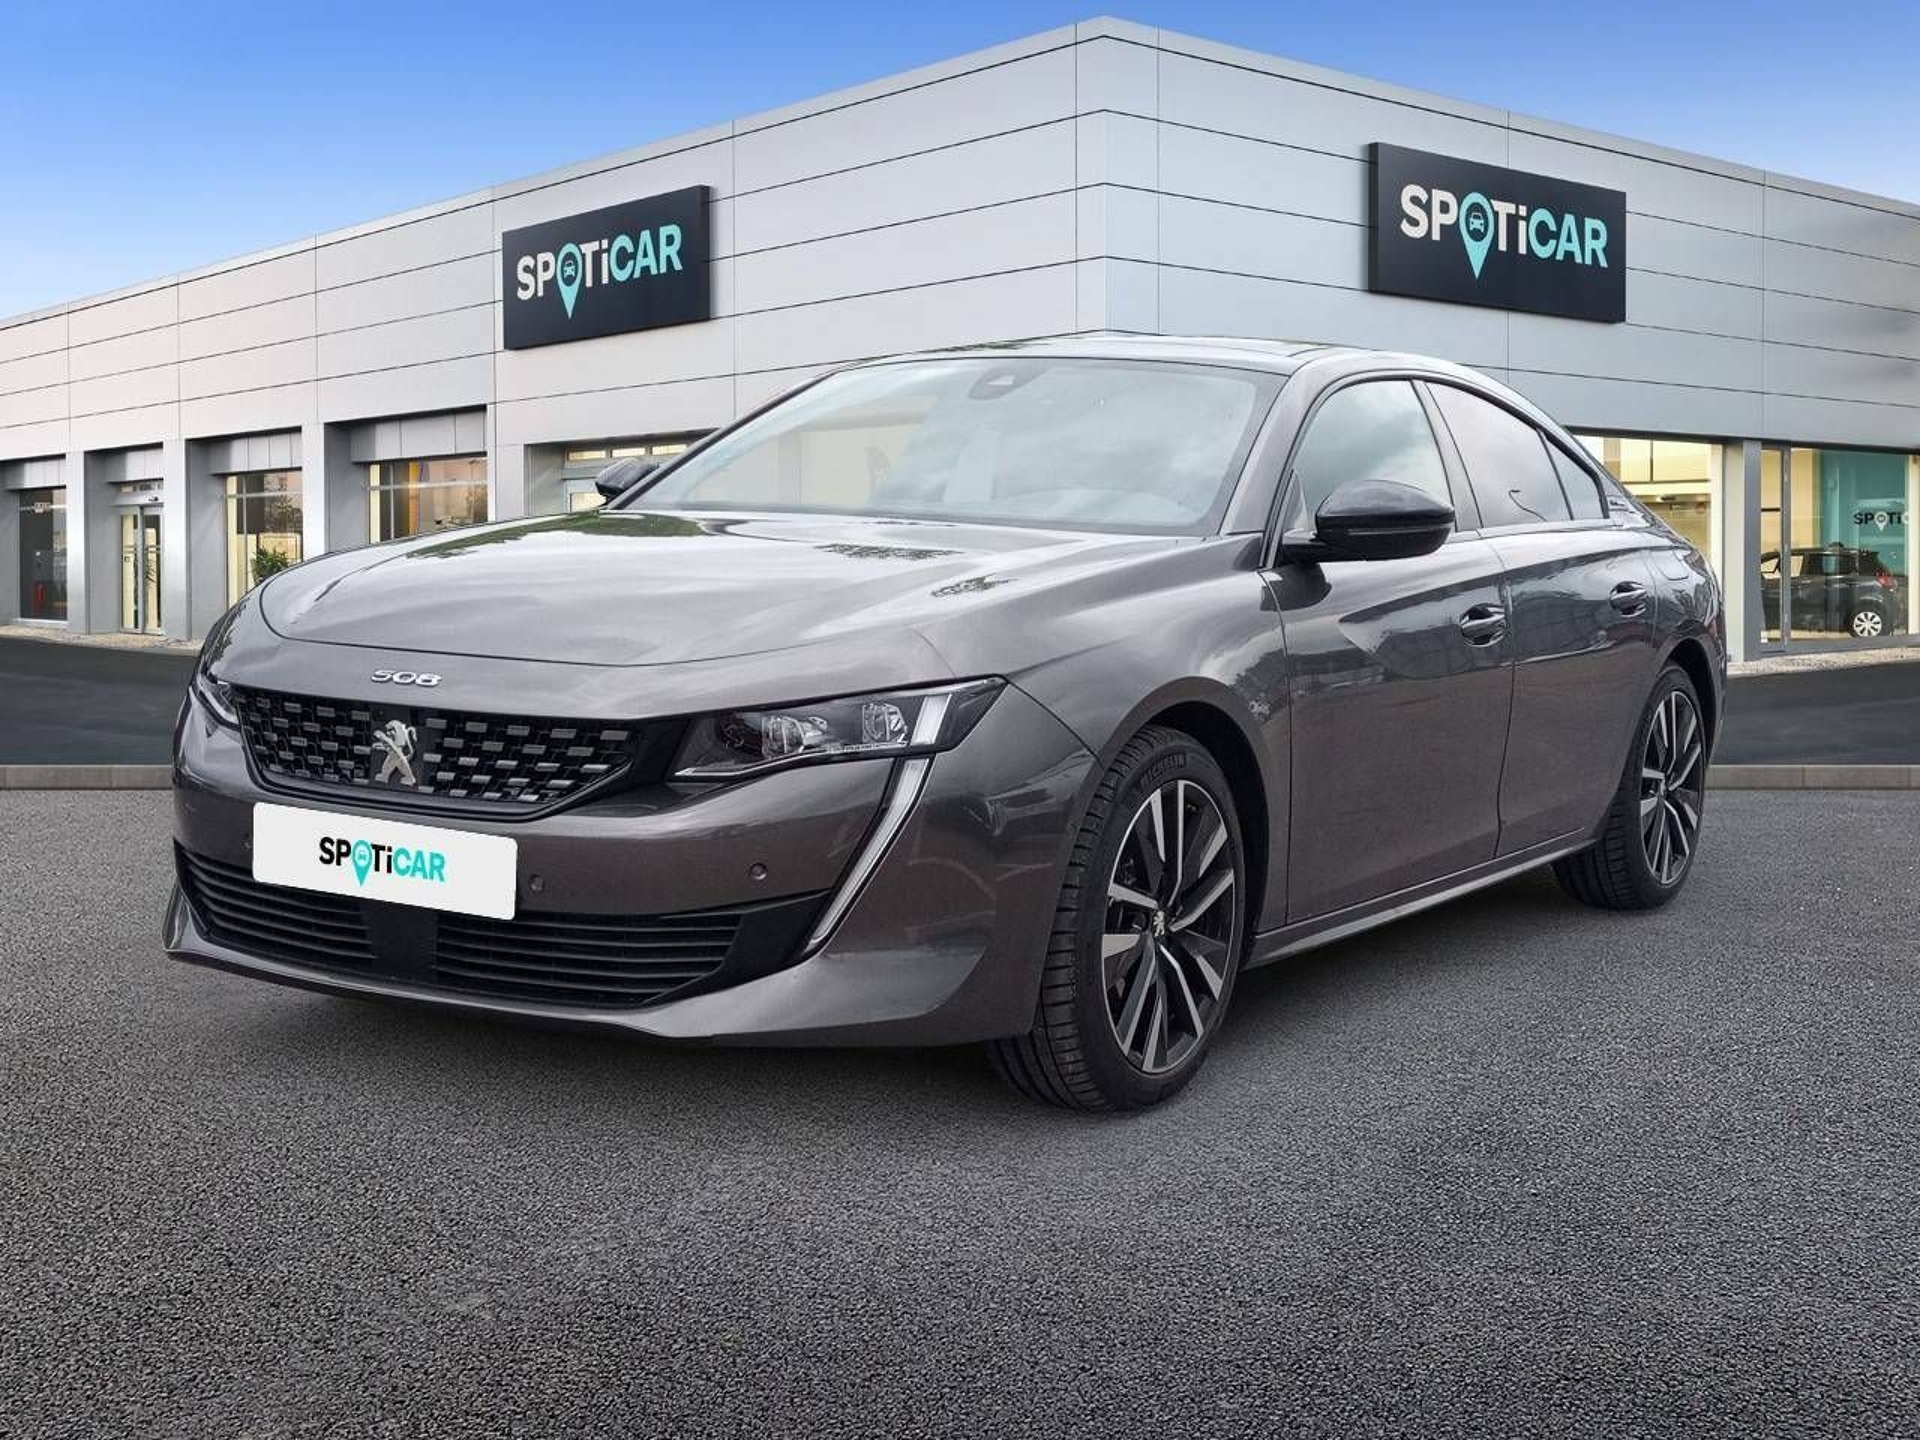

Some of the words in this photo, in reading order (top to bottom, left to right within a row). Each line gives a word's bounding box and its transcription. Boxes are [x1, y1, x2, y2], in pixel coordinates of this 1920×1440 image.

[1400, 184, 1608, 279] SPOTiCAR
[516, 224, 683, 319] SPOTiCAR
[371, 669, 442, 687] 508
[319, 837, 447, 887] SPOTiCAR
